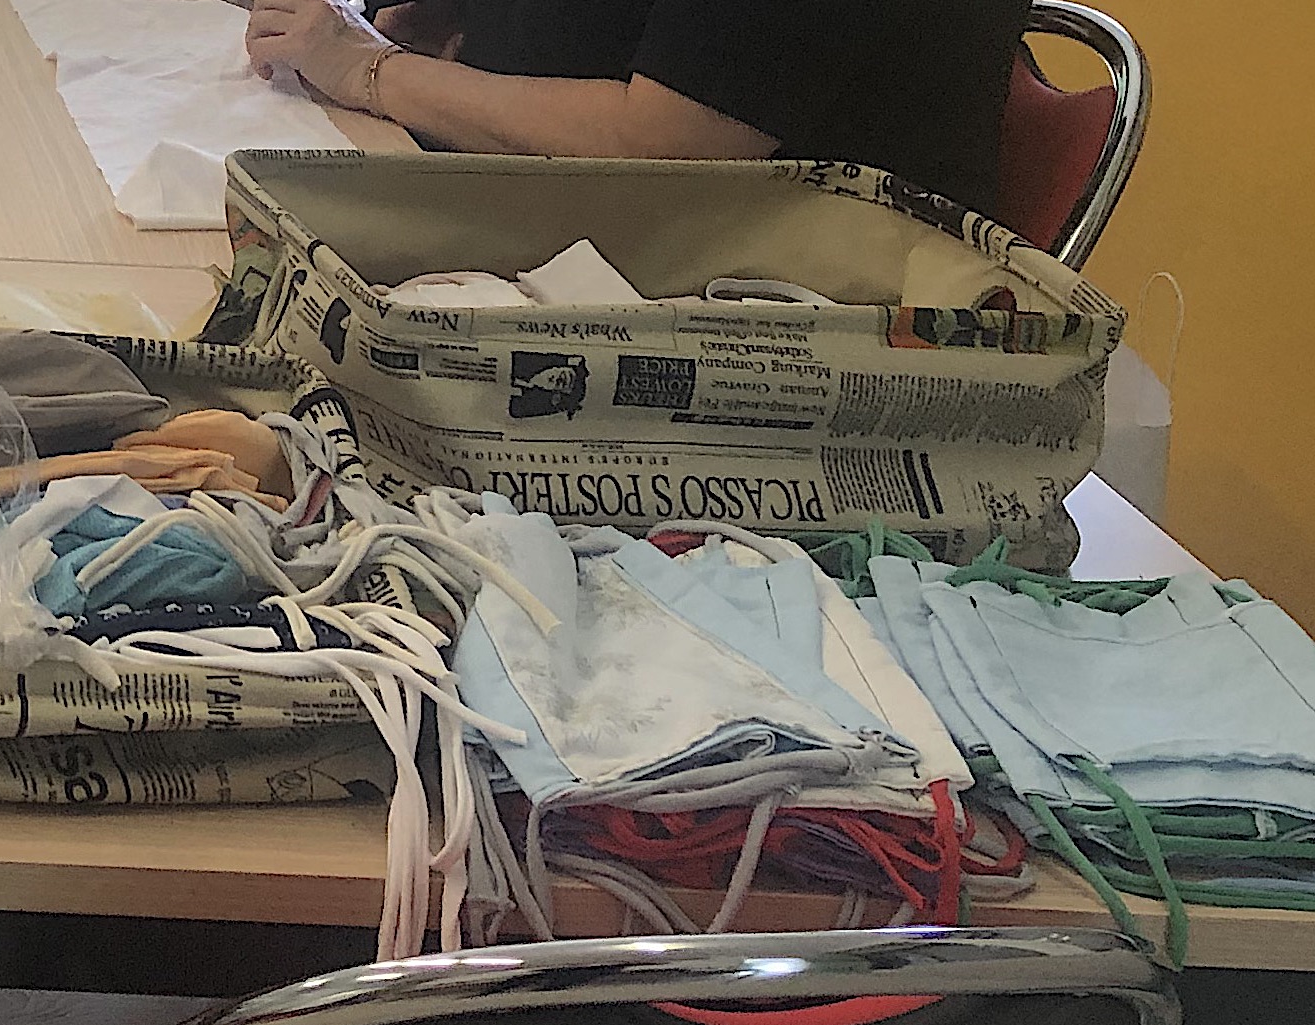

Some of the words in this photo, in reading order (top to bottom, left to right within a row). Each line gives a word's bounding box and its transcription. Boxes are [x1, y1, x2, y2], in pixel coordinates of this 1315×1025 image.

[406, 310, 459, 332] New
[516, 321, 567, 339] News
[571, 323, 633, 342] What's
[638, 358, 691, 376] PRICE
[696, 355, 766, 374] Company
[652, 475, 826, 523] PICASSO'S
